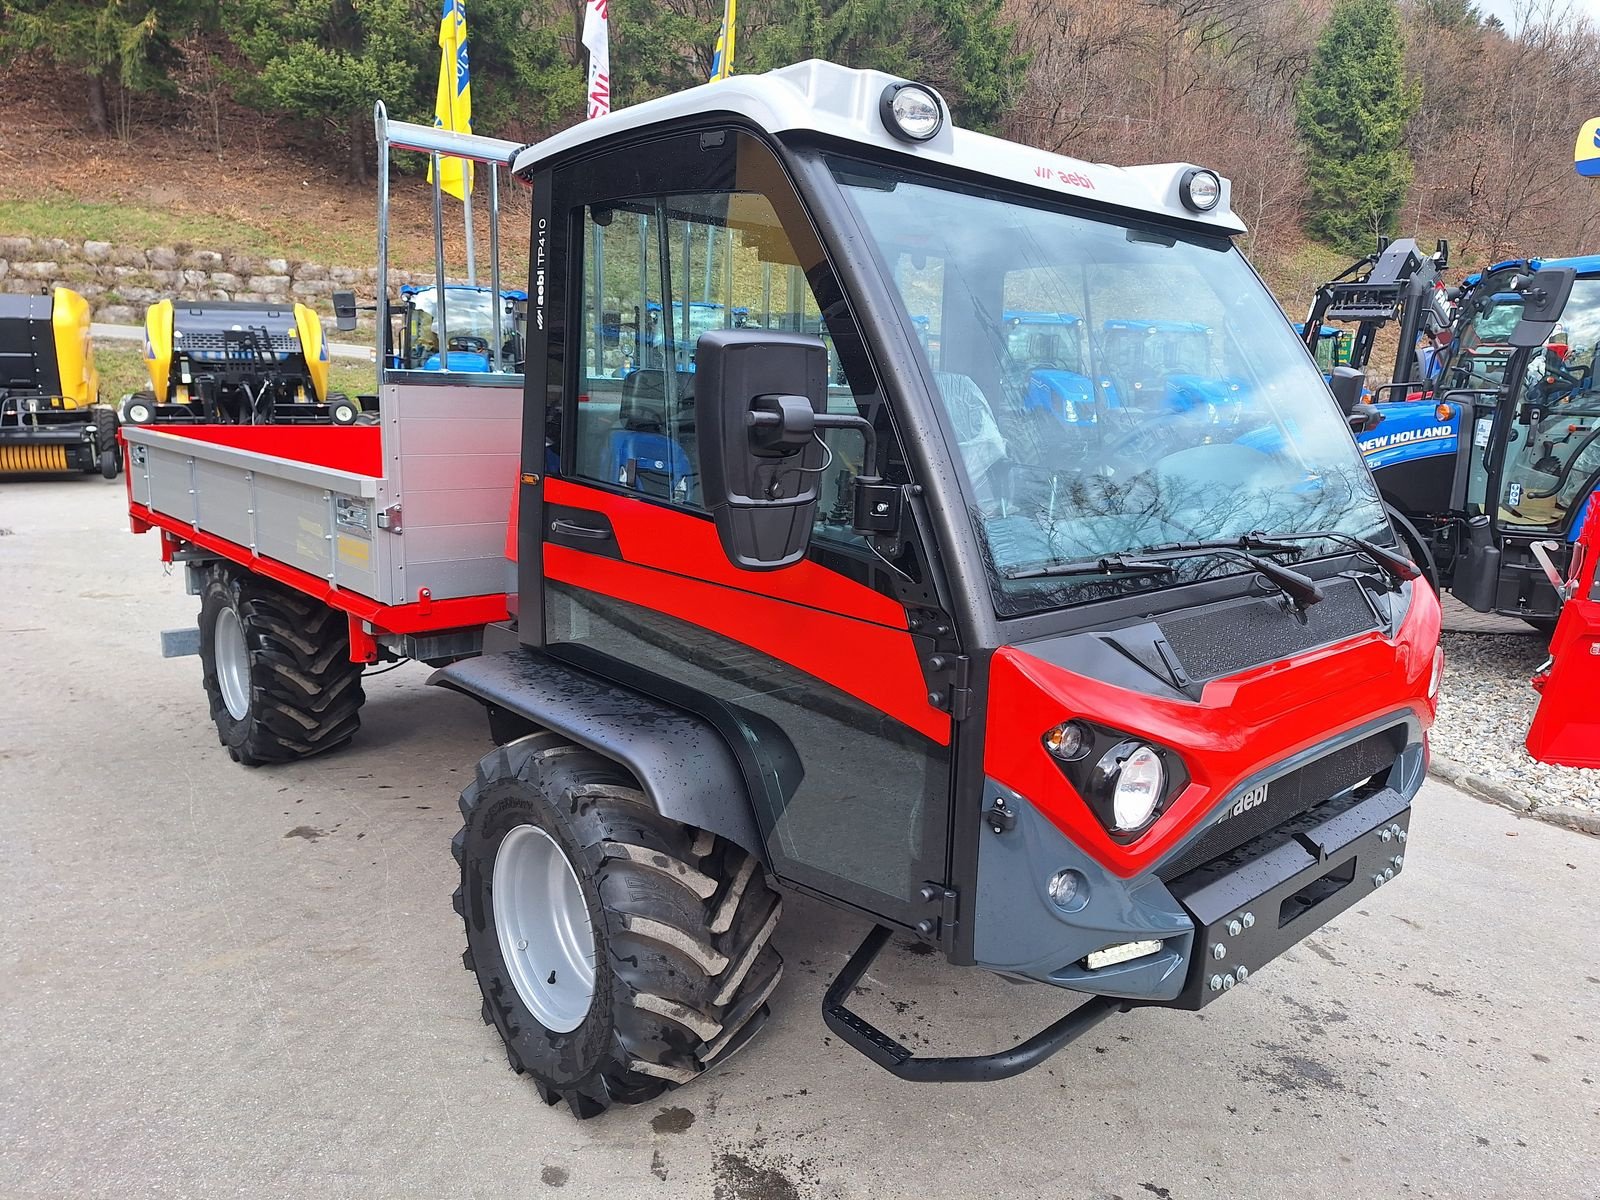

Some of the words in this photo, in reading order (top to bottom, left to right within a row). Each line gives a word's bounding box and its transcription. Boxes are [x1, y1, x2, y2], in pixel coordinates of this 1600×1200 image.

[1057, 170, 1095, 190] aebi
[537, 218, 546, 266] TP410
[536, 269, 544, 306] aebi
[1358, 435, 1389, 451] NEW
[1390, 425, 1452, 444] HOLLAND
[1233, 783, 1269, 816] aebi
